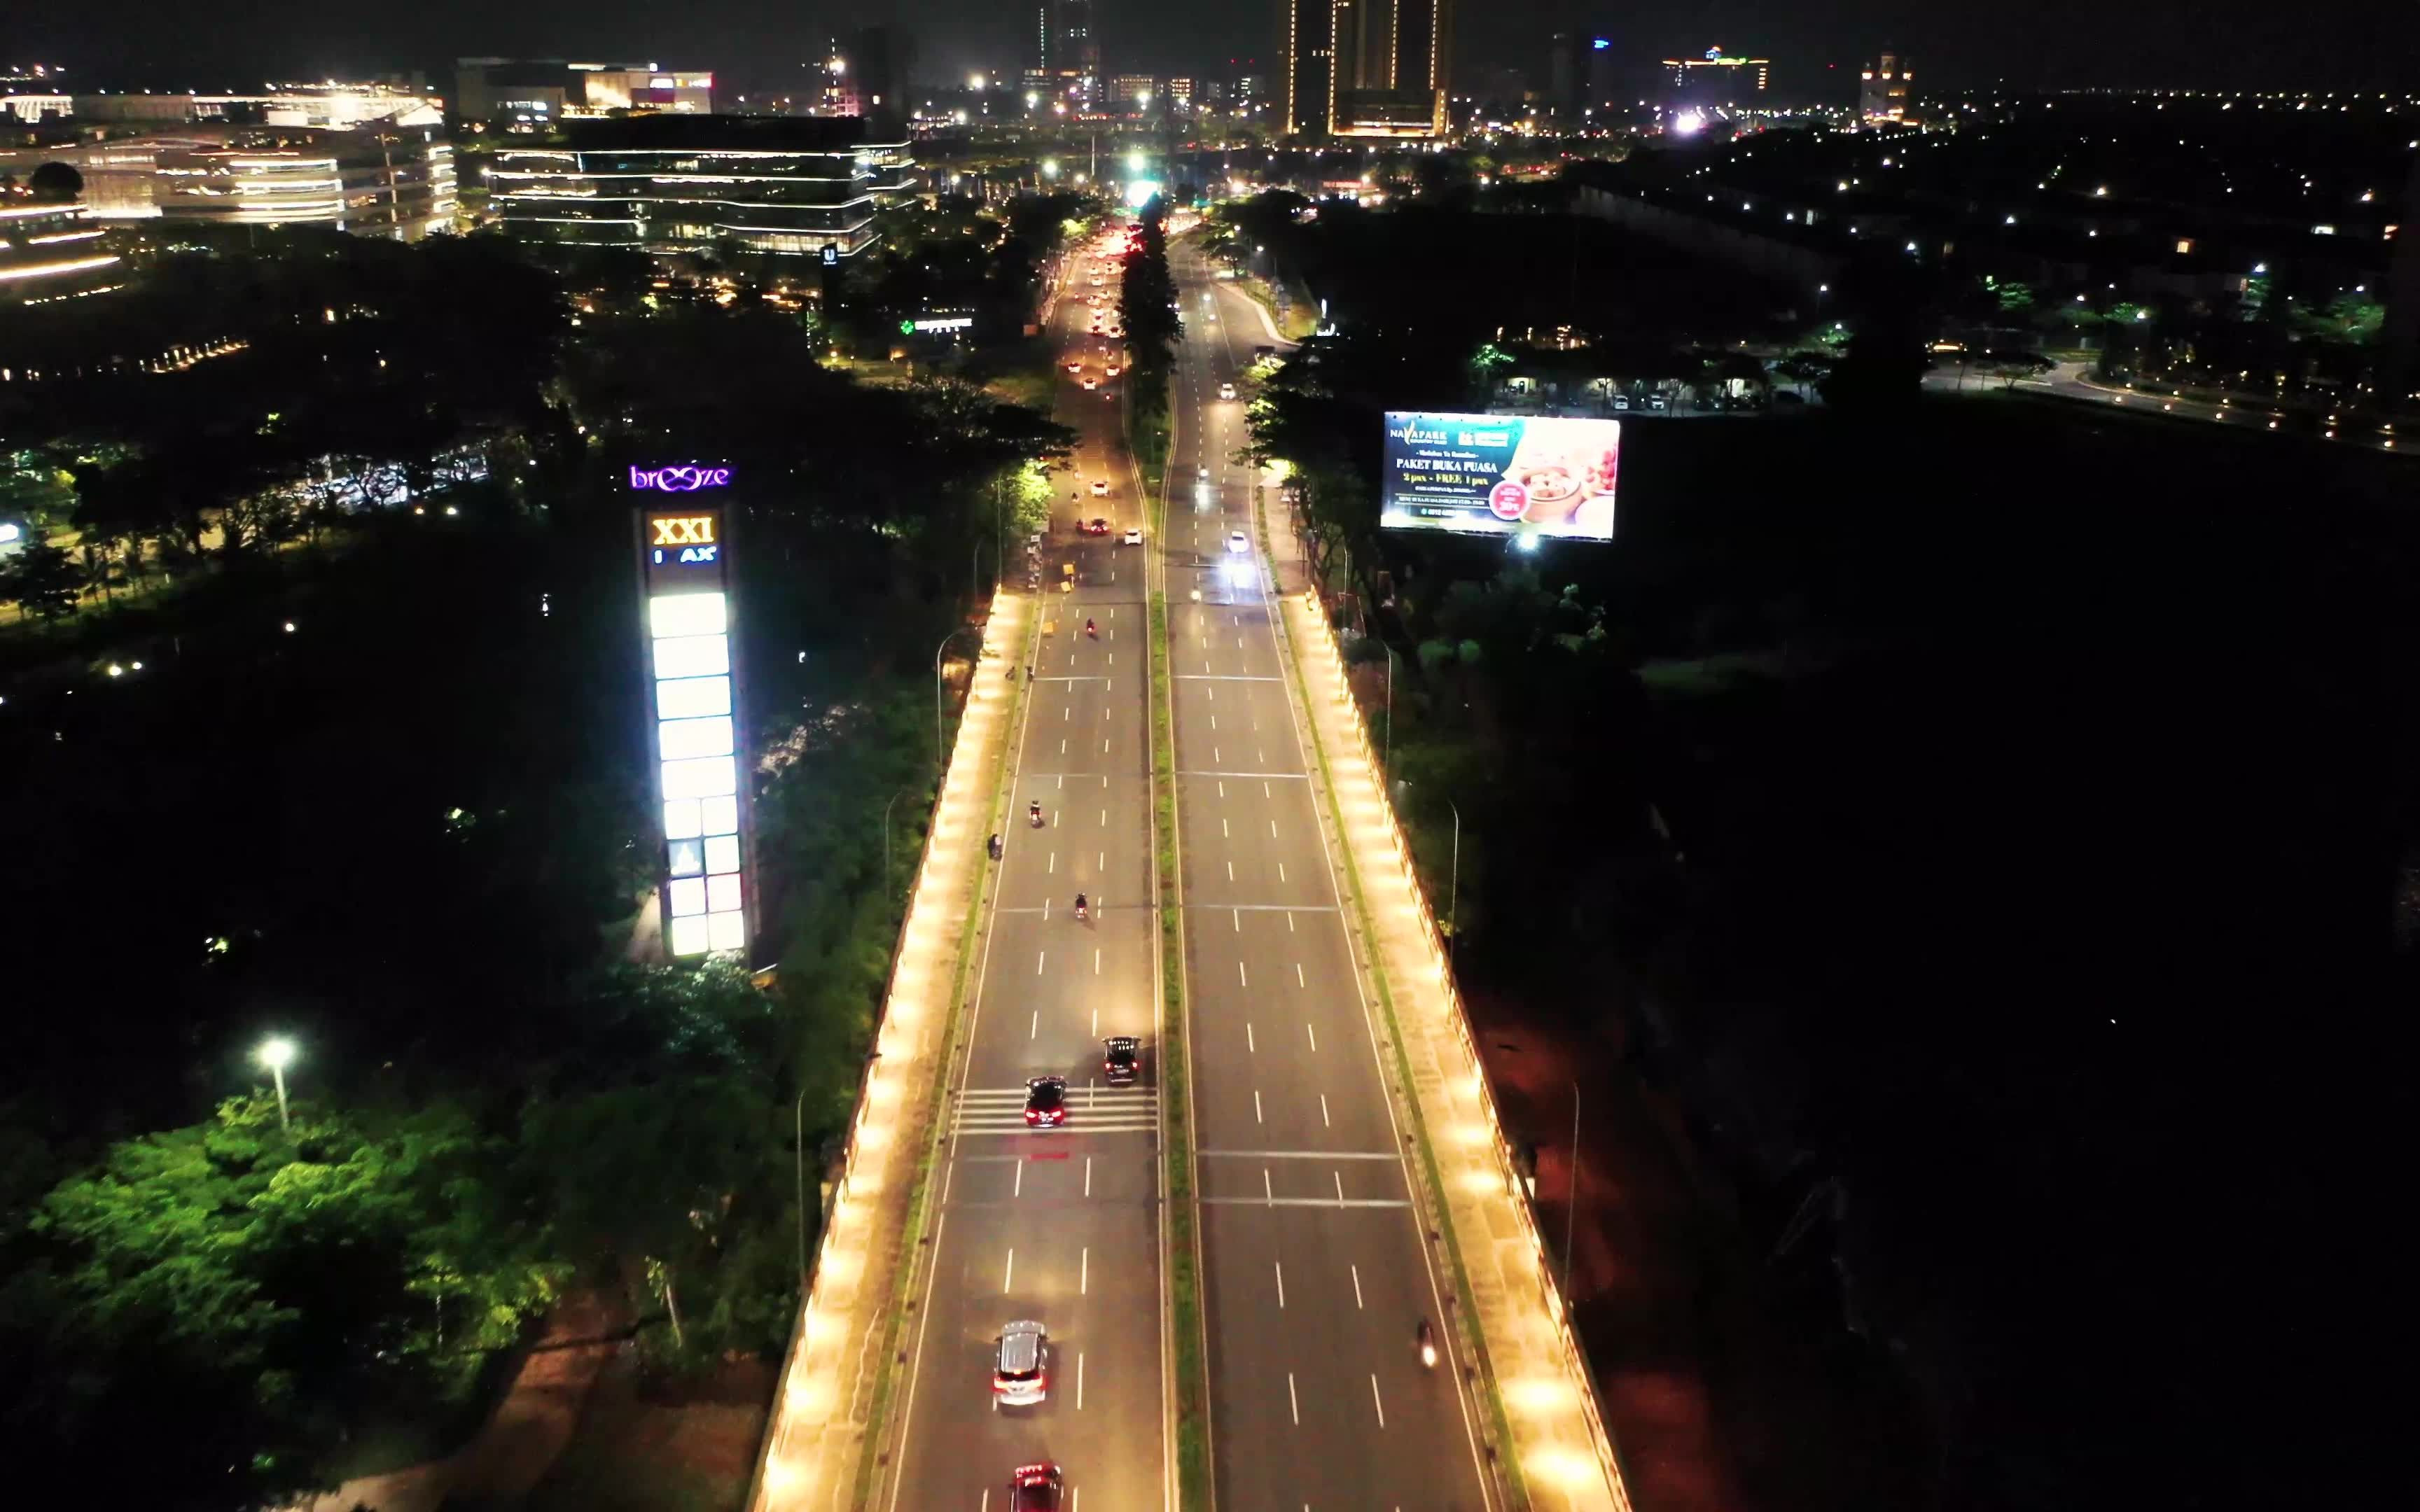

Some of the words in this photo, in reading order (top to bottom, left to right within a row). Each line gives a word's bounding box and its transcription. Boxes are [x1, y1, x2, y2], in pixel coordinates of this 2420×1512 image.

[1396, 458, 1431, 470] PAKET
[1432, 461, 1462, 472] BUKA
[1463, 462, 1498, 473] PUASA
[1403, 472, 1410, 481] 2
[1435, 473, 1463, 484] FREE
[653, 517, 714, 545] XXI
